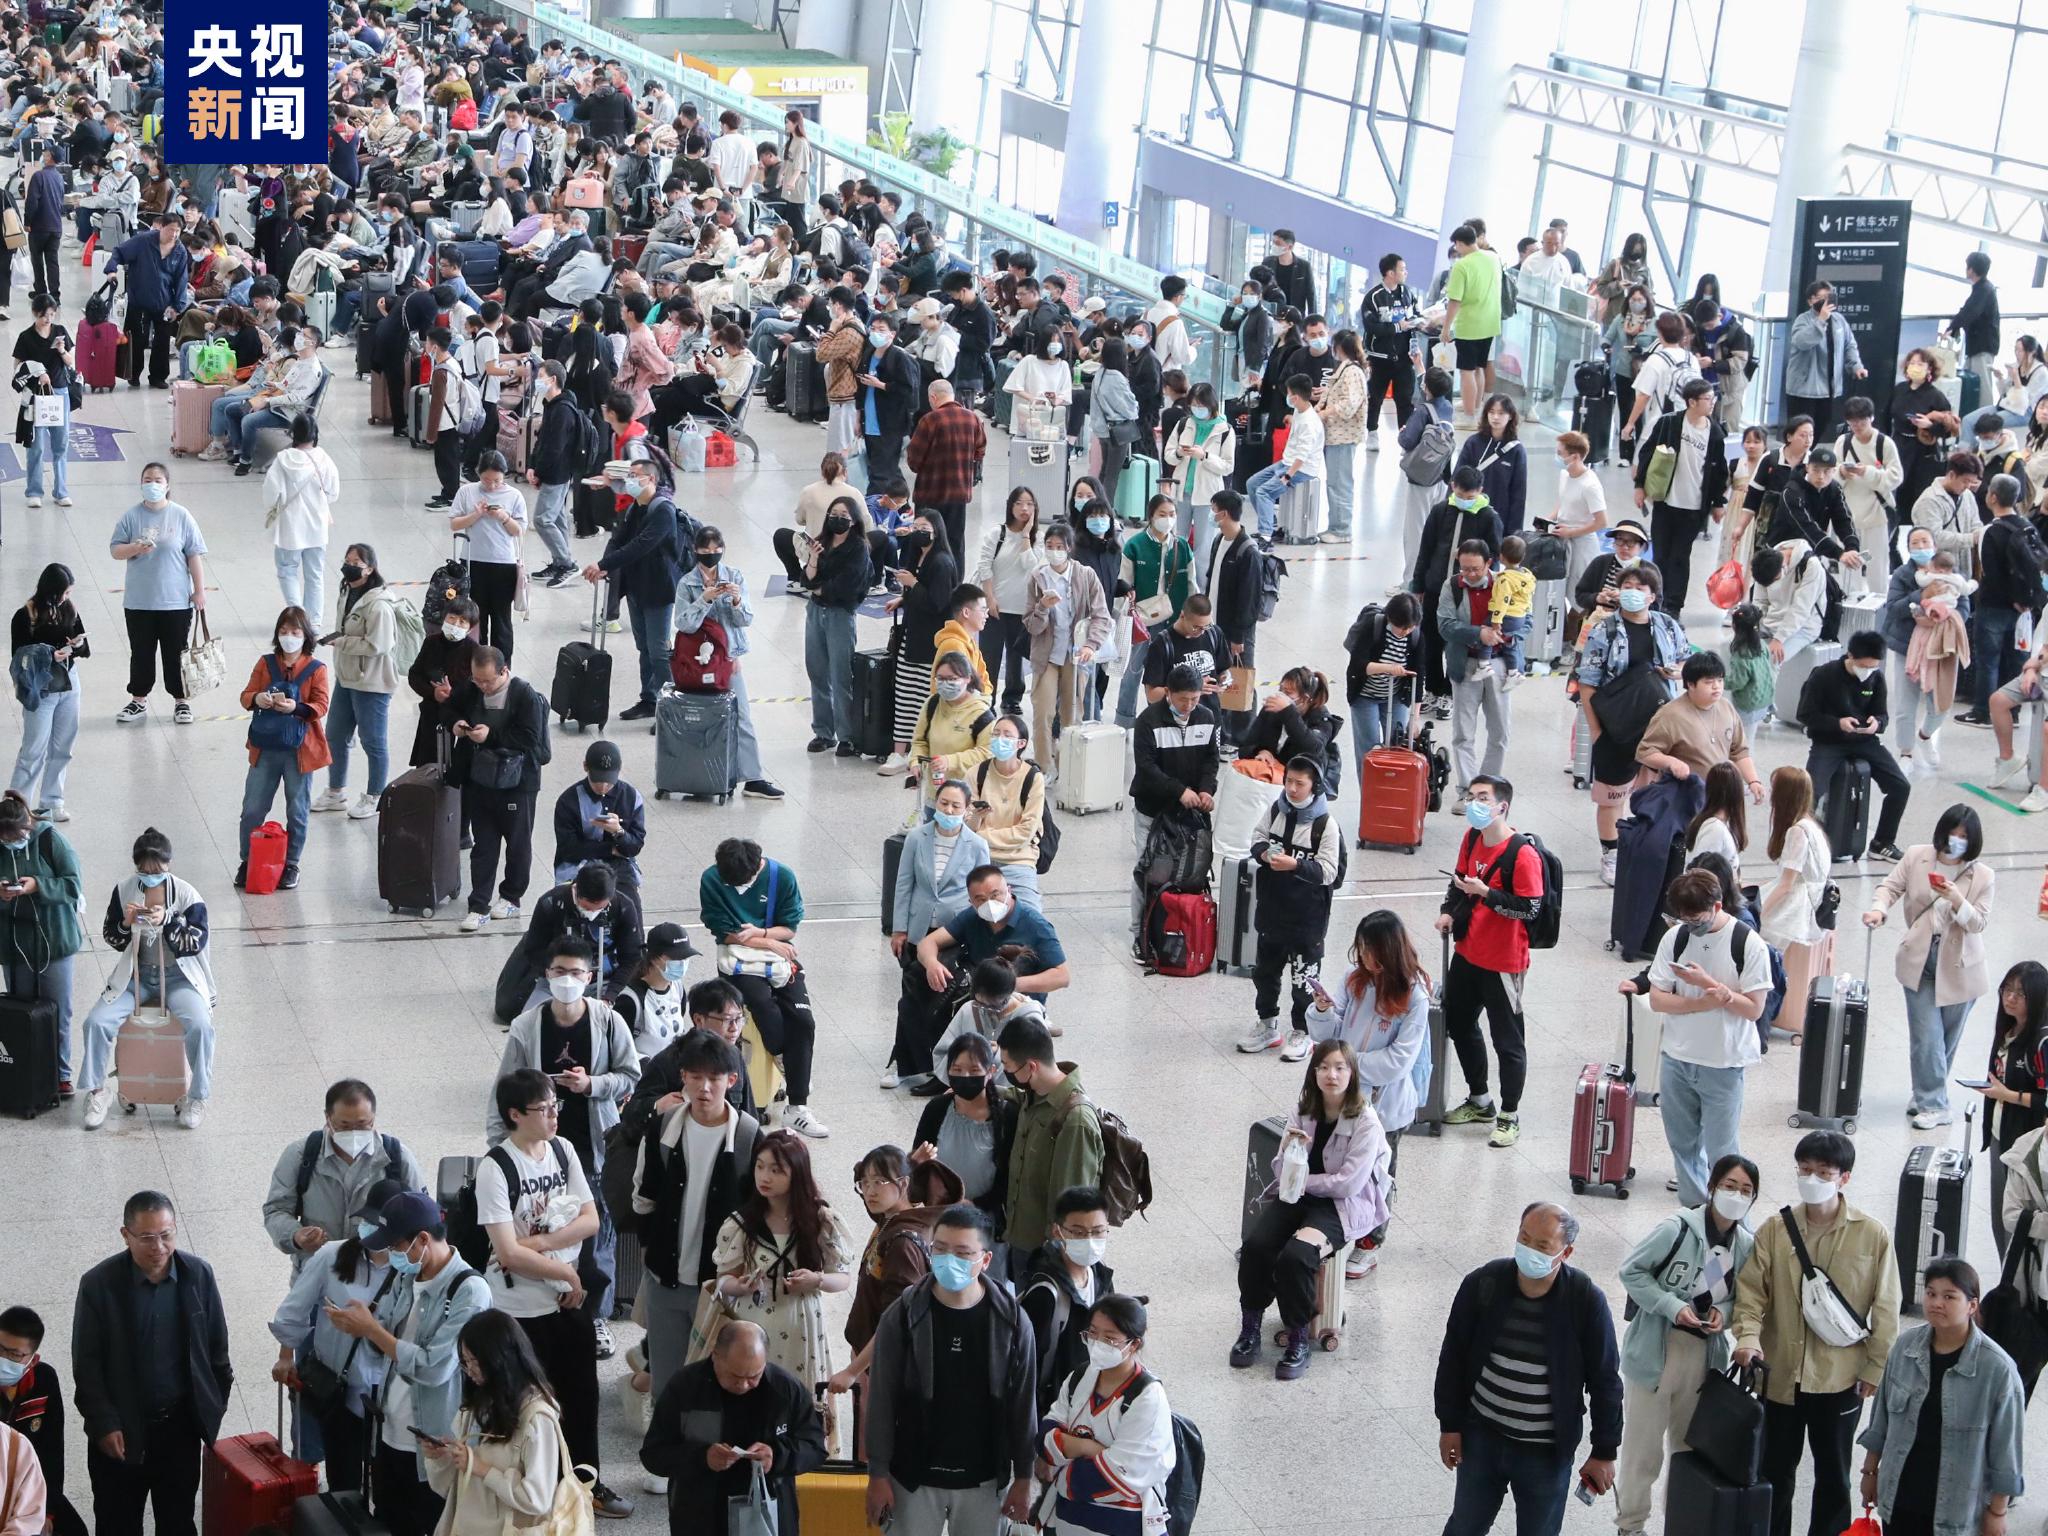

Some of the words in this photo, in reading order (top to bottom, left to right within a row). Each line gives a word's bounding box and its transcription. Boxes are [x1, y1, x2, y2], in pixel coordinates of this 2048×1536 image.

[1107, 205, 1116, 225] 入口
[1856, 215, 1899, 228] 候车大厅
[1834, 216, 1855, 232] 1F
[1839, 286, 1854, 294] 出口
[1184, 652, 1200, 662] THE
